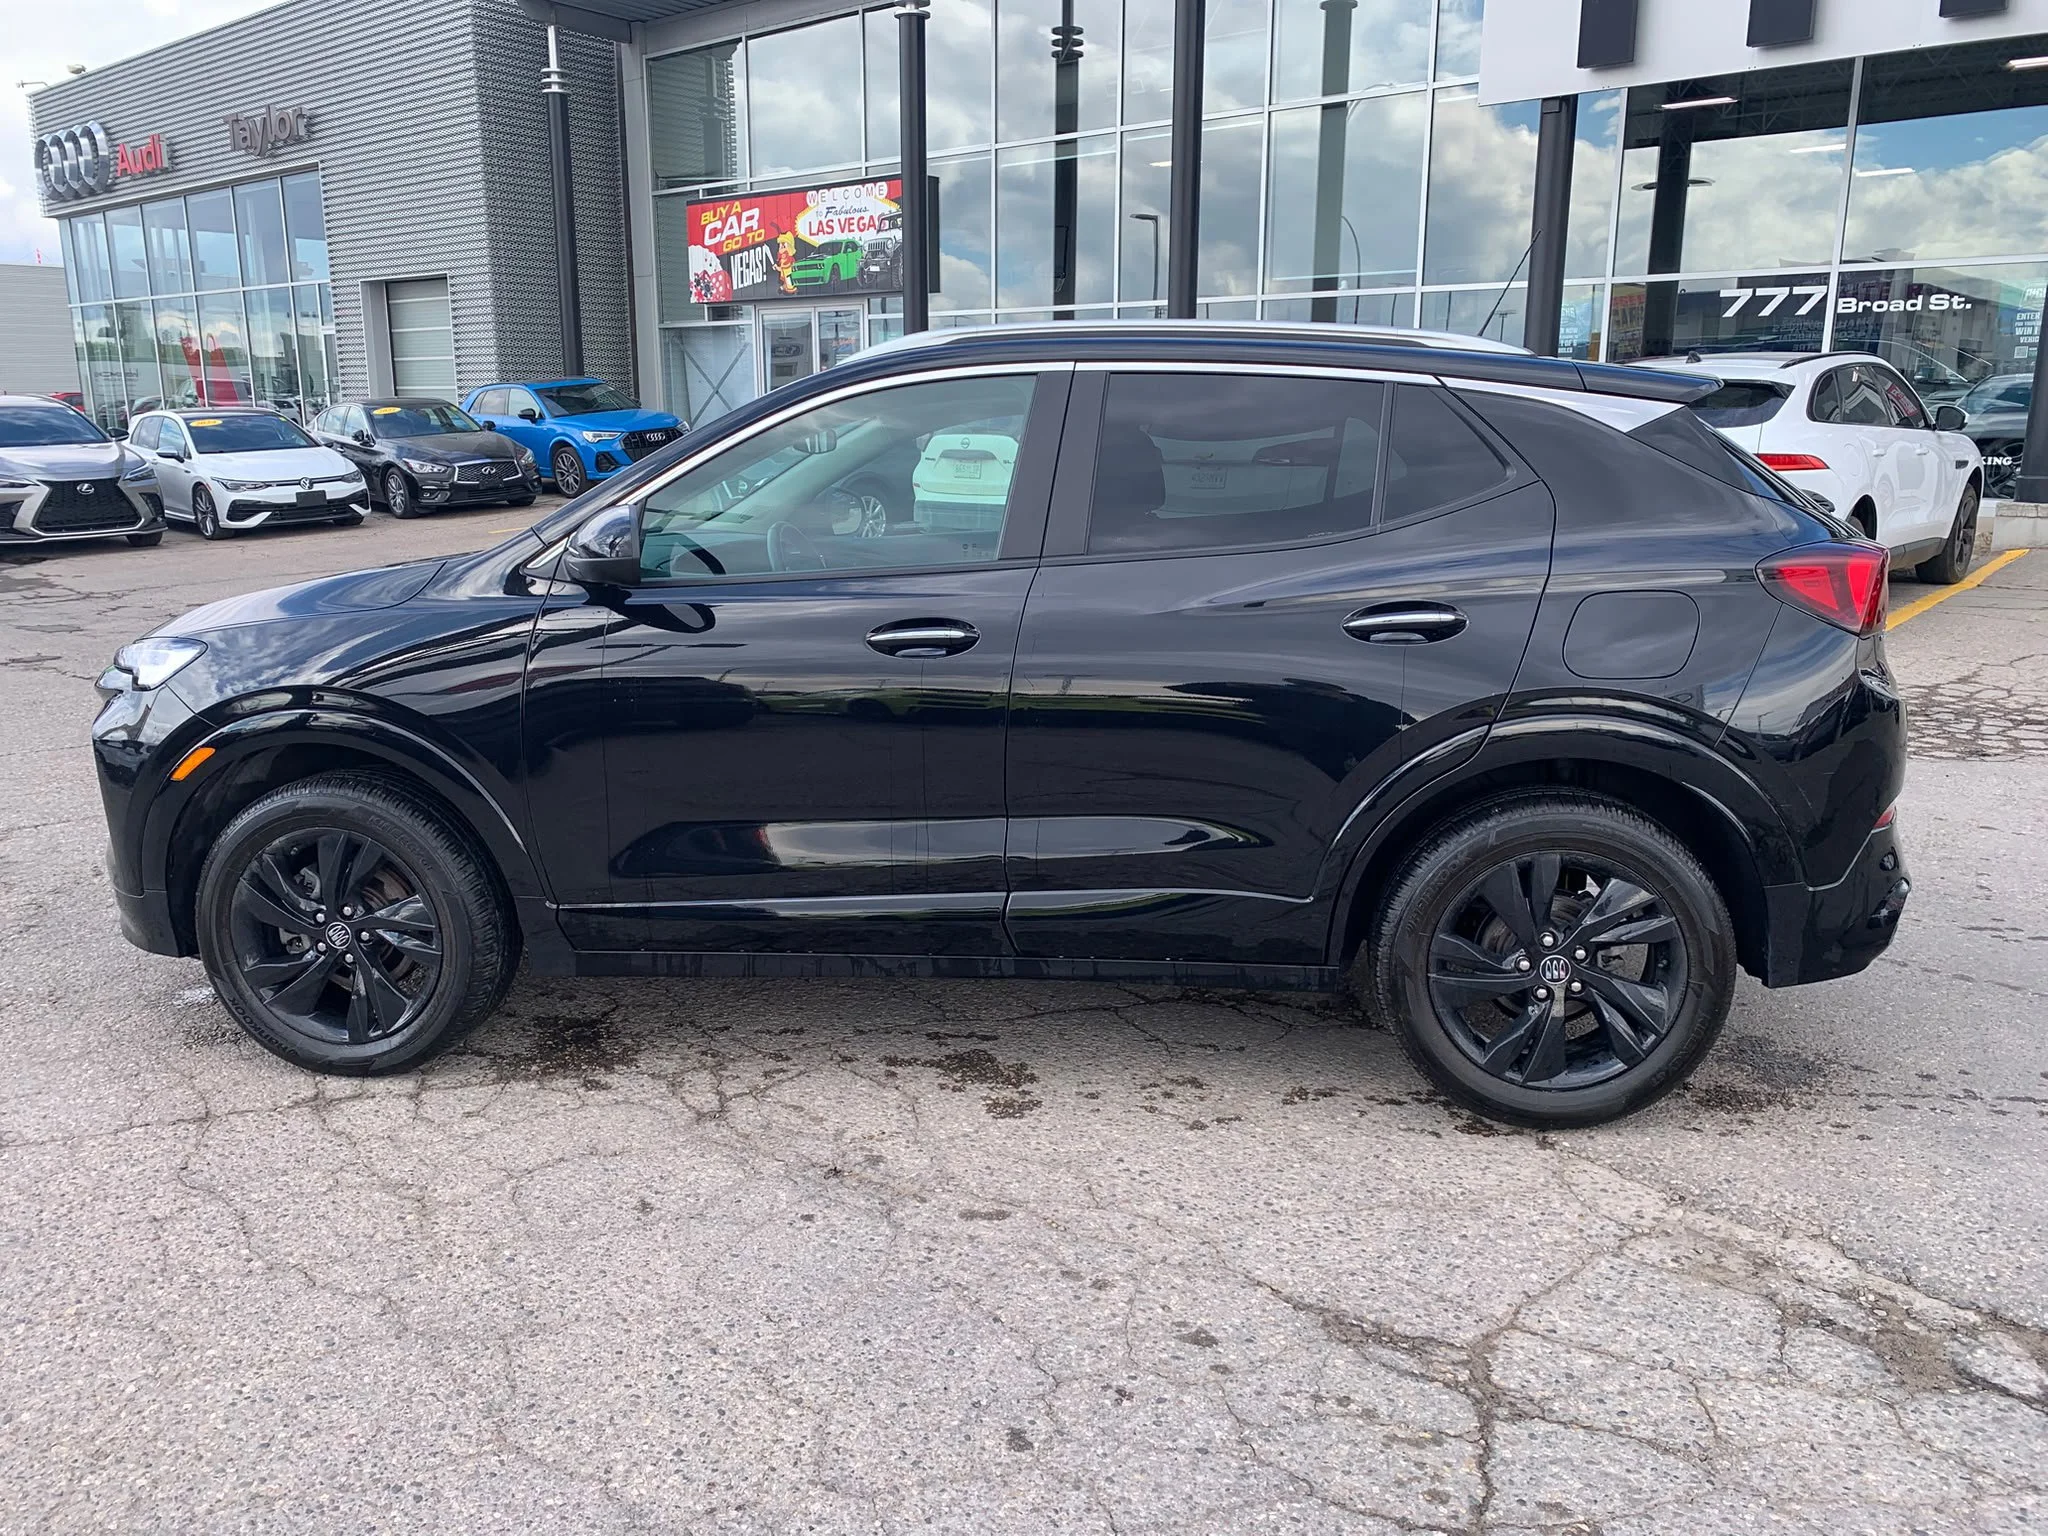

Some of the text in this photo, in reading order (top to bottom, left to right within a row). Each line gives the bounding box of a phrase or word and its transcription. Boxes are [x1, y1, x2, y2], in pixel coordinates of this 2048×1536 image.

[223, 104, 312, 157] Taylor
[115, 133, 170, 177] Audi
[808, 184, 885, 204] WELCOME
[700, 201, 742, 225] BUY A
[824, 205, 870, 218] Fabulous
[704, 207, 760, 246] CAR
[808, 218, 835, 237] LAS
[723, 228, 765, 252] GO TO
[730, 244, 767, 290] VEGAS!
[1719, 285, 1829, 318] 777
[1836, 294, 1924, 314] Broad
[1928, 293, 1973, 311] St.
[1981, 456, 2013, 466] KING
